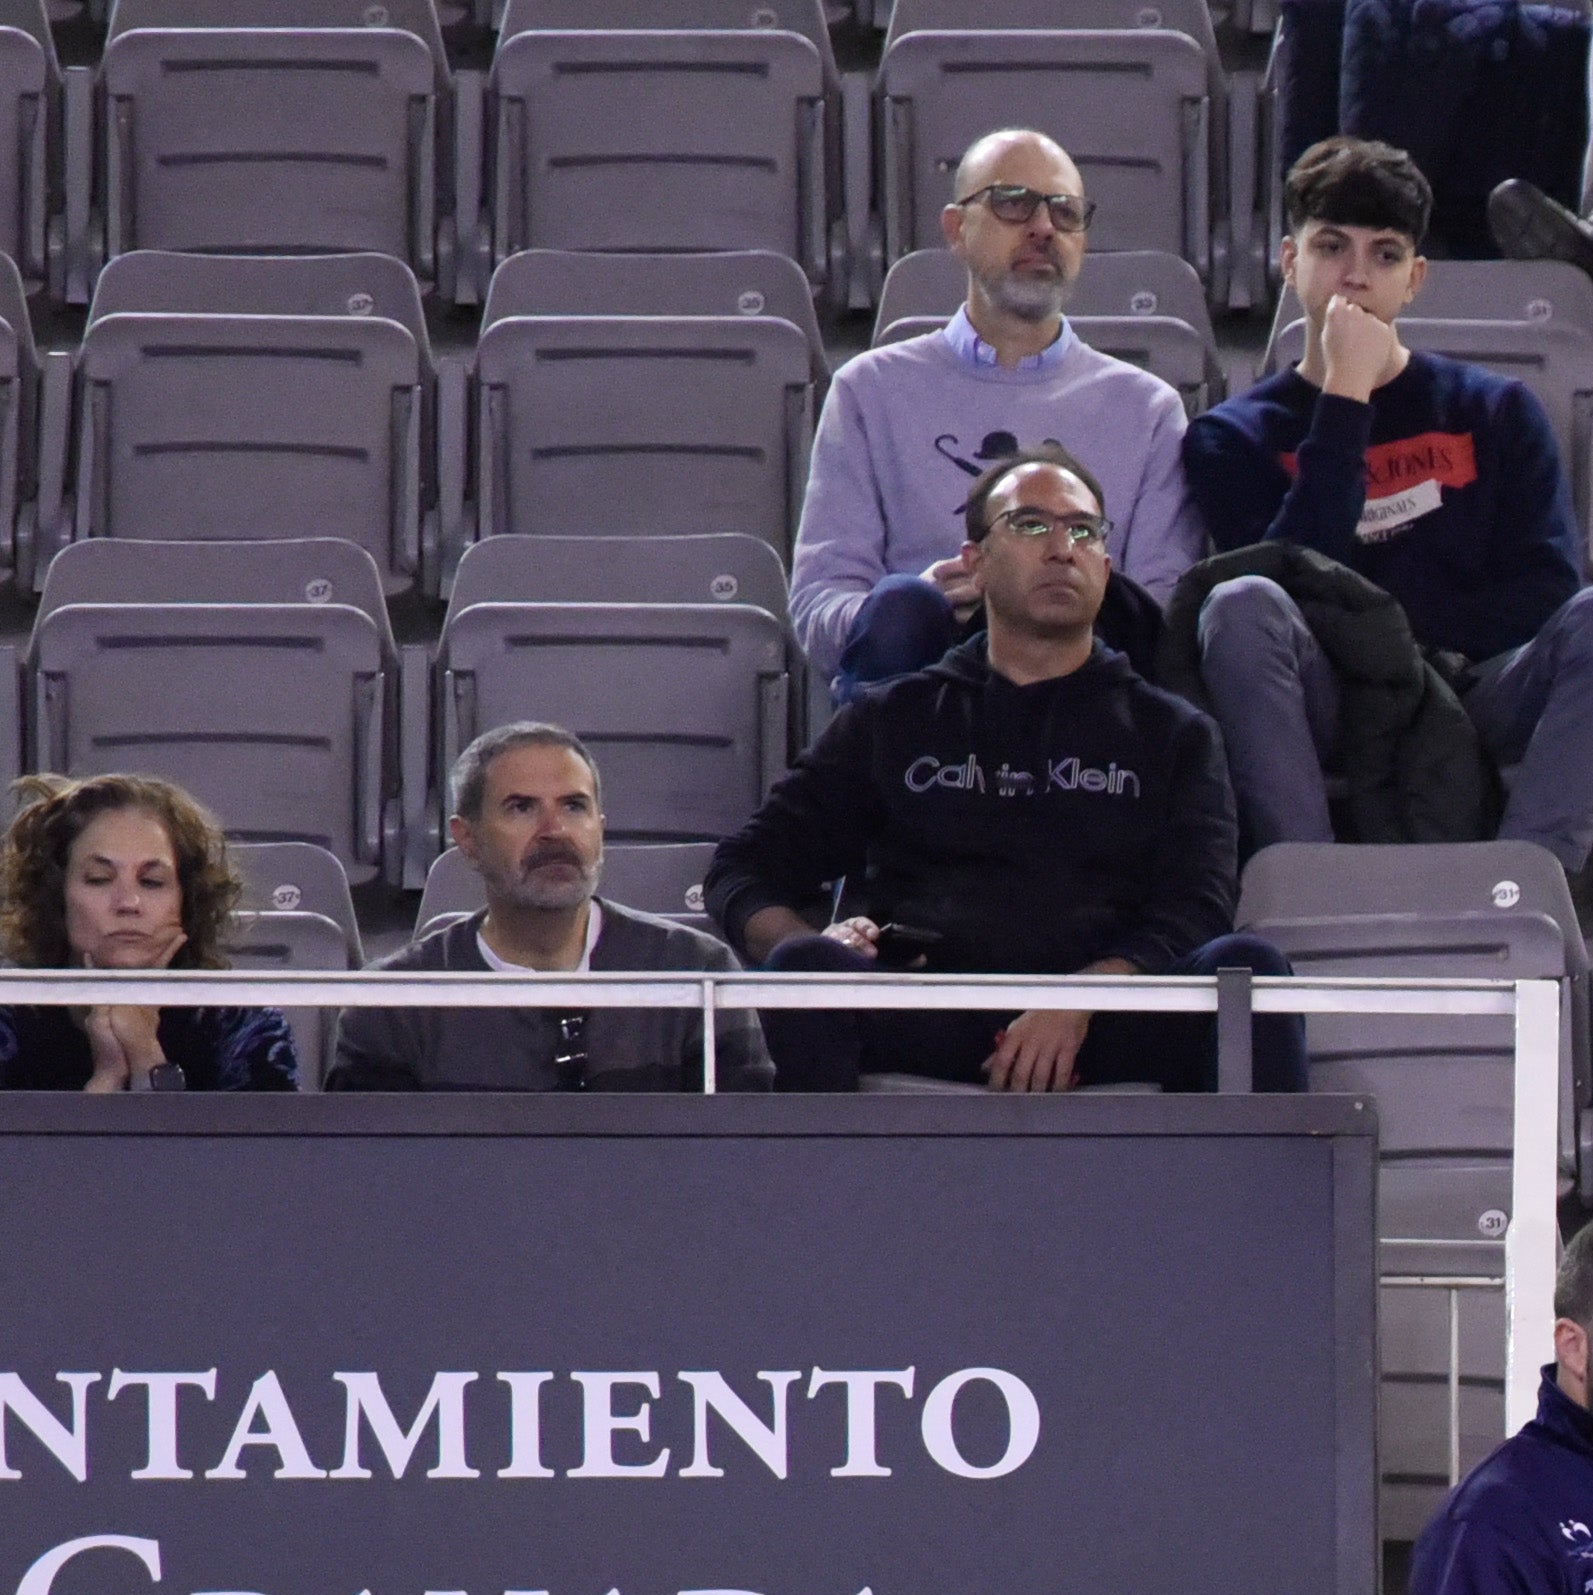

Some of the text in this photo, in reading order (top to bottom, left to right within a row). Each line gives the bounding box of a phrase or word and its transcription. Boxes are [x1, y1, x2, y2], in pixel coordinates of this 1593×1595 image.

[1362, 497, 1417, 522] RIGINALS
[1044, 757, 1141, 798] Klein
[0, 1366, 1042, 1480] NTAMIENTO
